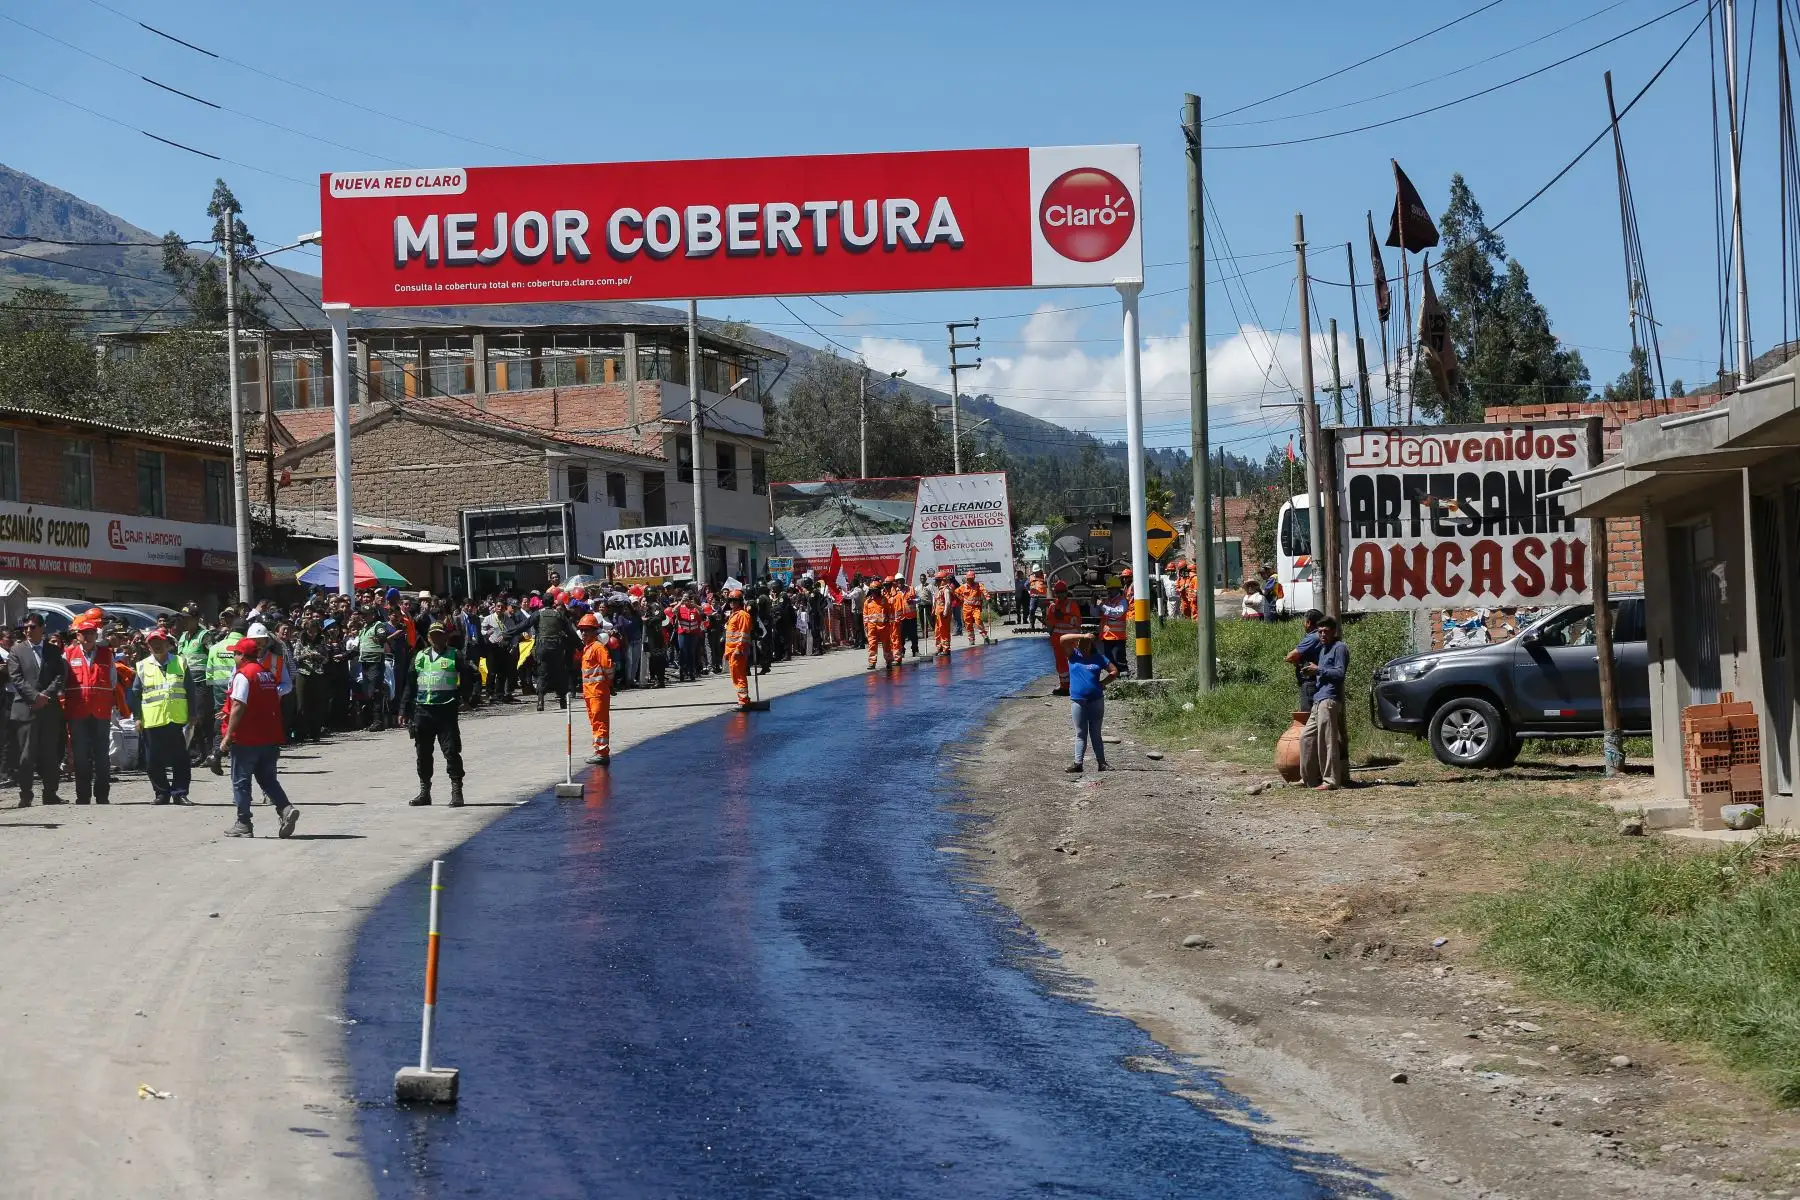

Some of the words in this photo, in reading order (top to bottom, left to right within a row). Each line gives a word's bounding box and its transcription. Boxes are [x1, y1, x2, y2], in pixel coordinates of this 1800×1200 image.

[334, 177, 380, 190] NUEVA
[384, 176, 412, 189] RED
[415, 174, 461, 188] CLARO
[1045, 204, 1117, 227] Claro
[393, 209, 591, 267] MEJOR
[606, 196, 965, 261] COBERTURA
[394, 282, 433, 292] Consulta
[434, 282, 443, 291] la
[445, 280, 487, 291] cobertura
[489, 279, 509, 289] total
[511, 279, 525, 288] en:
[527, 275, 632, 288] cobertura.claro.com.pe/
[1346, 425, 1577, 469] Bienvenidos
[921, 500, 1002, 513] ACELERANDO
[1350, 468, 1575, 538] ARTESANIA
[921, 515, 931, 523] LA
[933, 511, 1004, 521] RECONSTRUCCIÓN
[921, 520, 947, 530] CON
[951, 517, 1005, 529] CAMBIOS
[47, 518, 91, 549] PEDRITO
[605, 529, 690, 552] ARTESANIA
[24, 556, 37, 570] POR
[40, 558, 61, 572] MAYOR
[64, 561, 68, 572] Y
[1349, 537, 1589, 601] ANCASH
